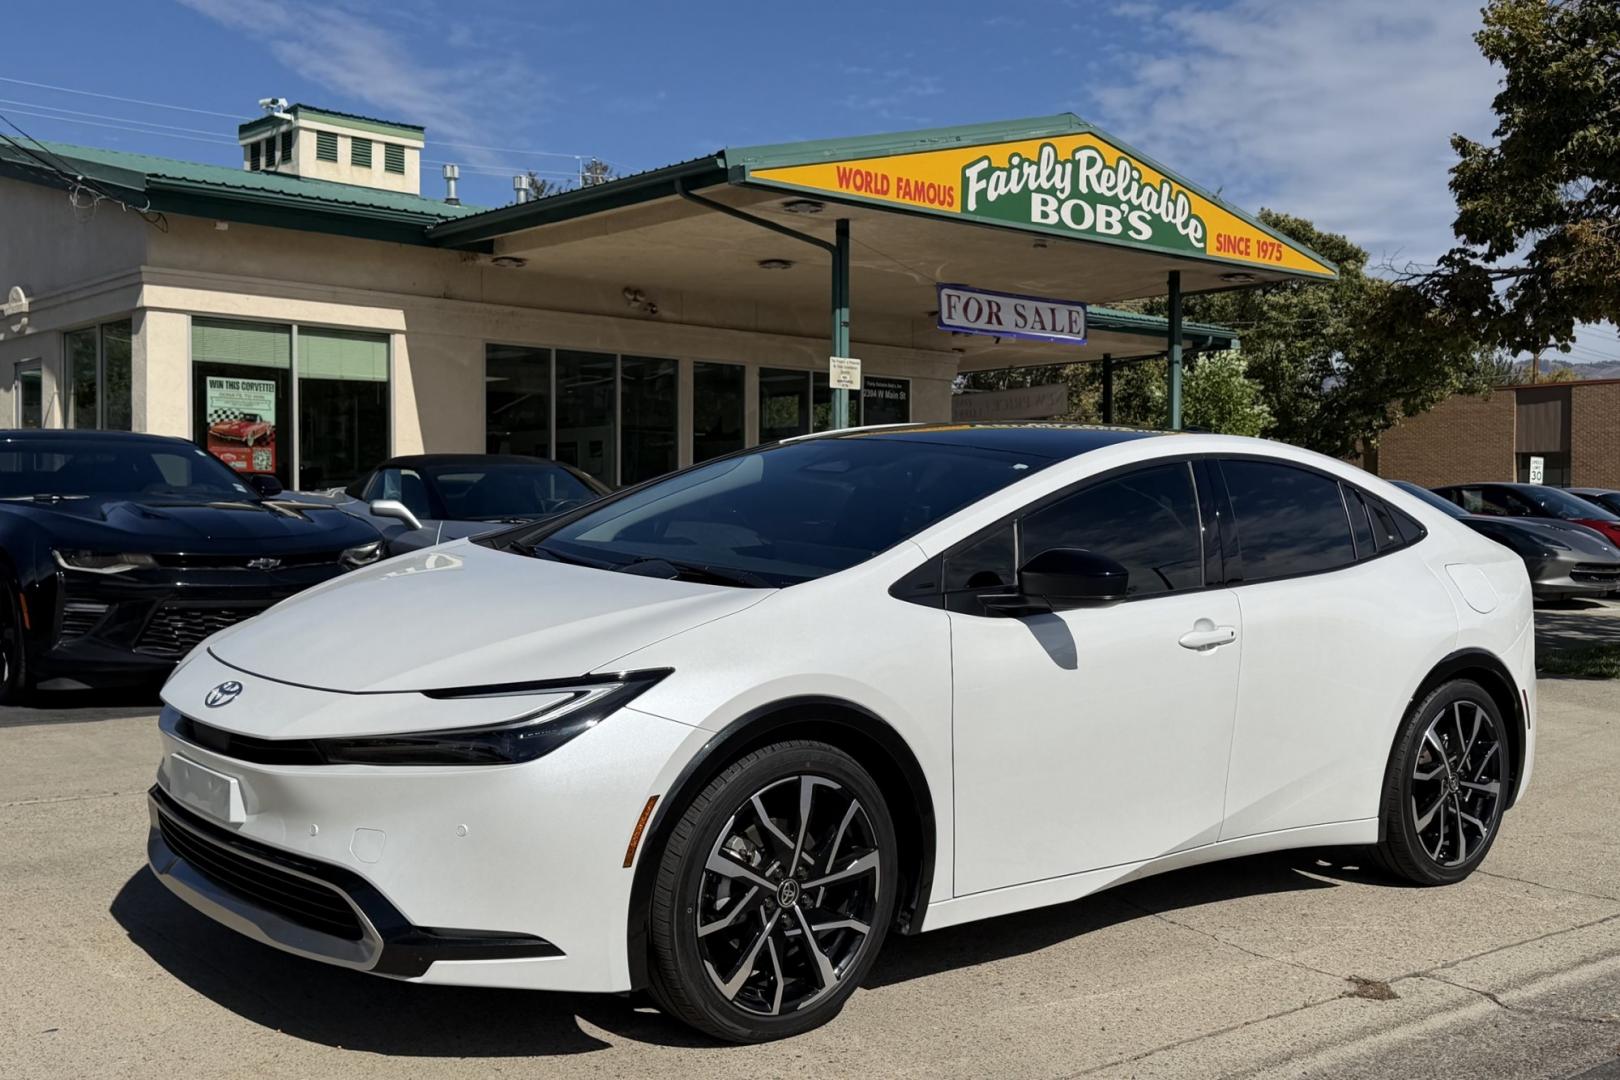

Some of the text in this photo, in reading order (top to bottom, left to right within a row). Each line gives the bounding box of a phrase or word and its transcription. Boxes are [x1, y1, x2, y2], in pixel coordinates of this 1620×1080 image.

[836, 166, 954, 208] WORLD FAMOUS
[965, 146, 1205, 248] Fairly Reliable
[1031, 193, 1152, 241] BOB'S
[1216, 233, 1283, 262] SINCE 1975
[945, 293, 1082, 335] FOR SALE
[209, 380, 275, 392] WIN THIS CORVETTE!
[877, 389, 884, 399] W
[885, 390, 899, 400] Main
[1532, 470, 1541, 480] 30
